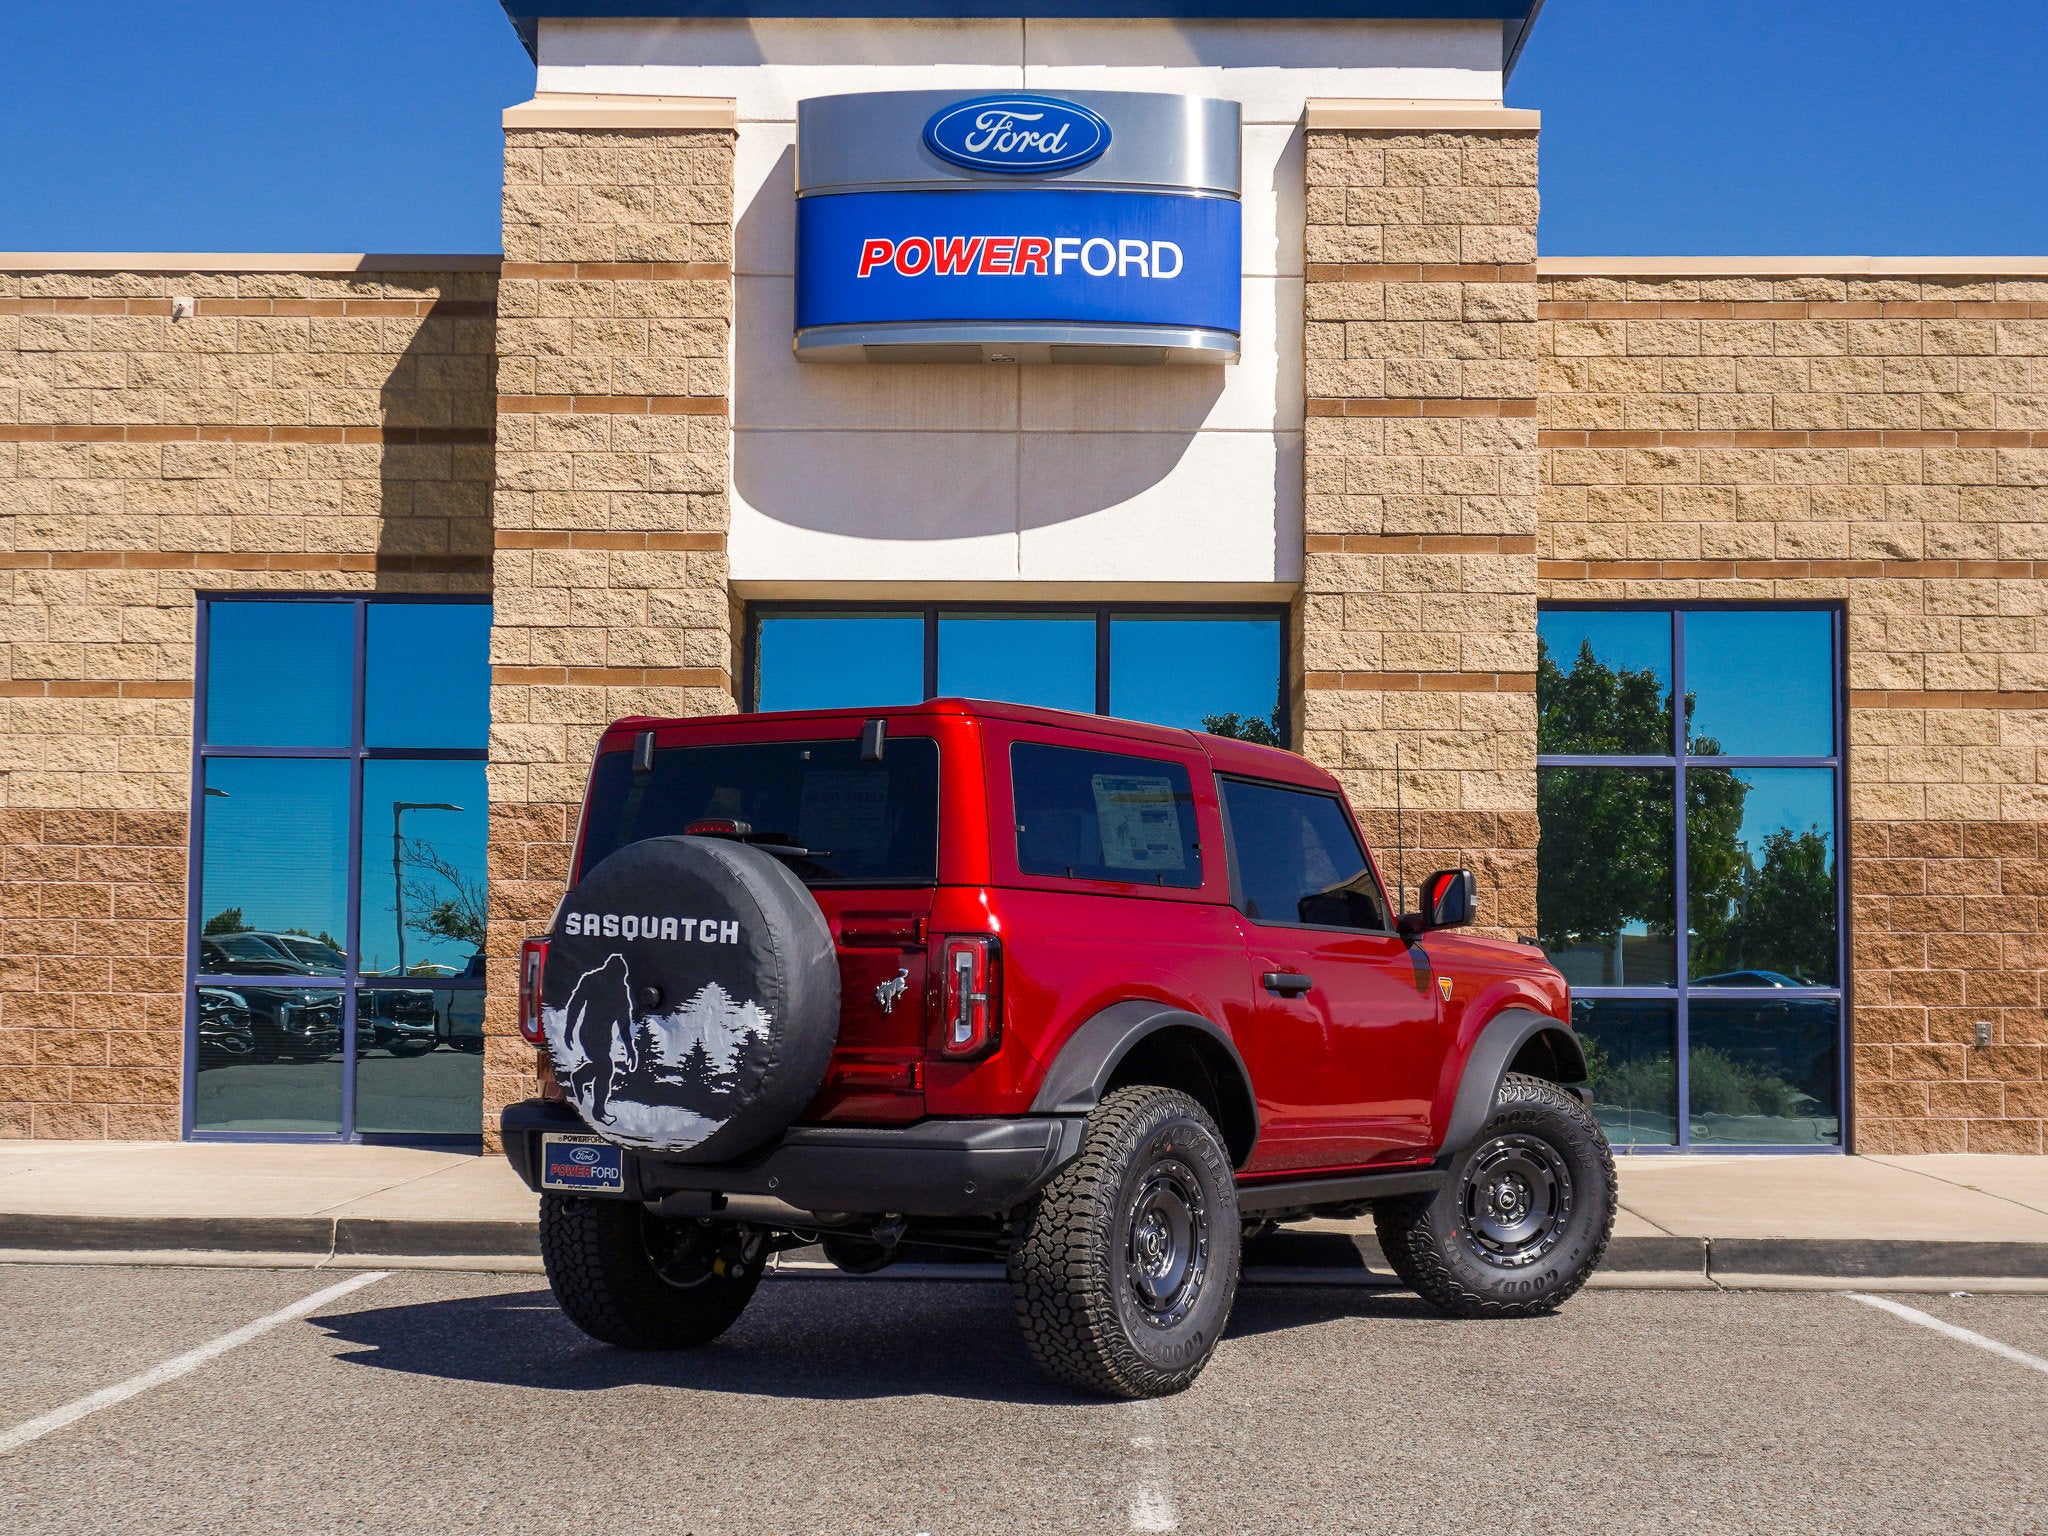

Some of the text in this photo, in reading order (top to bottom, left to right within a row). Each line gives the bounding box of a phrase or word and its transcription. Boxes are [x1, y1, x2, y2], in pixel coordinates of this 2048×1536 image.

[965, 110, 1070, 154] Ford
[857, 236, 1184, 279] POWERFORD
[565, 912, 739, 945] SASQUATCH
[550, 1164, 618, 1178] POWERFORD
[575, 1150, 594, 1160] Ford
